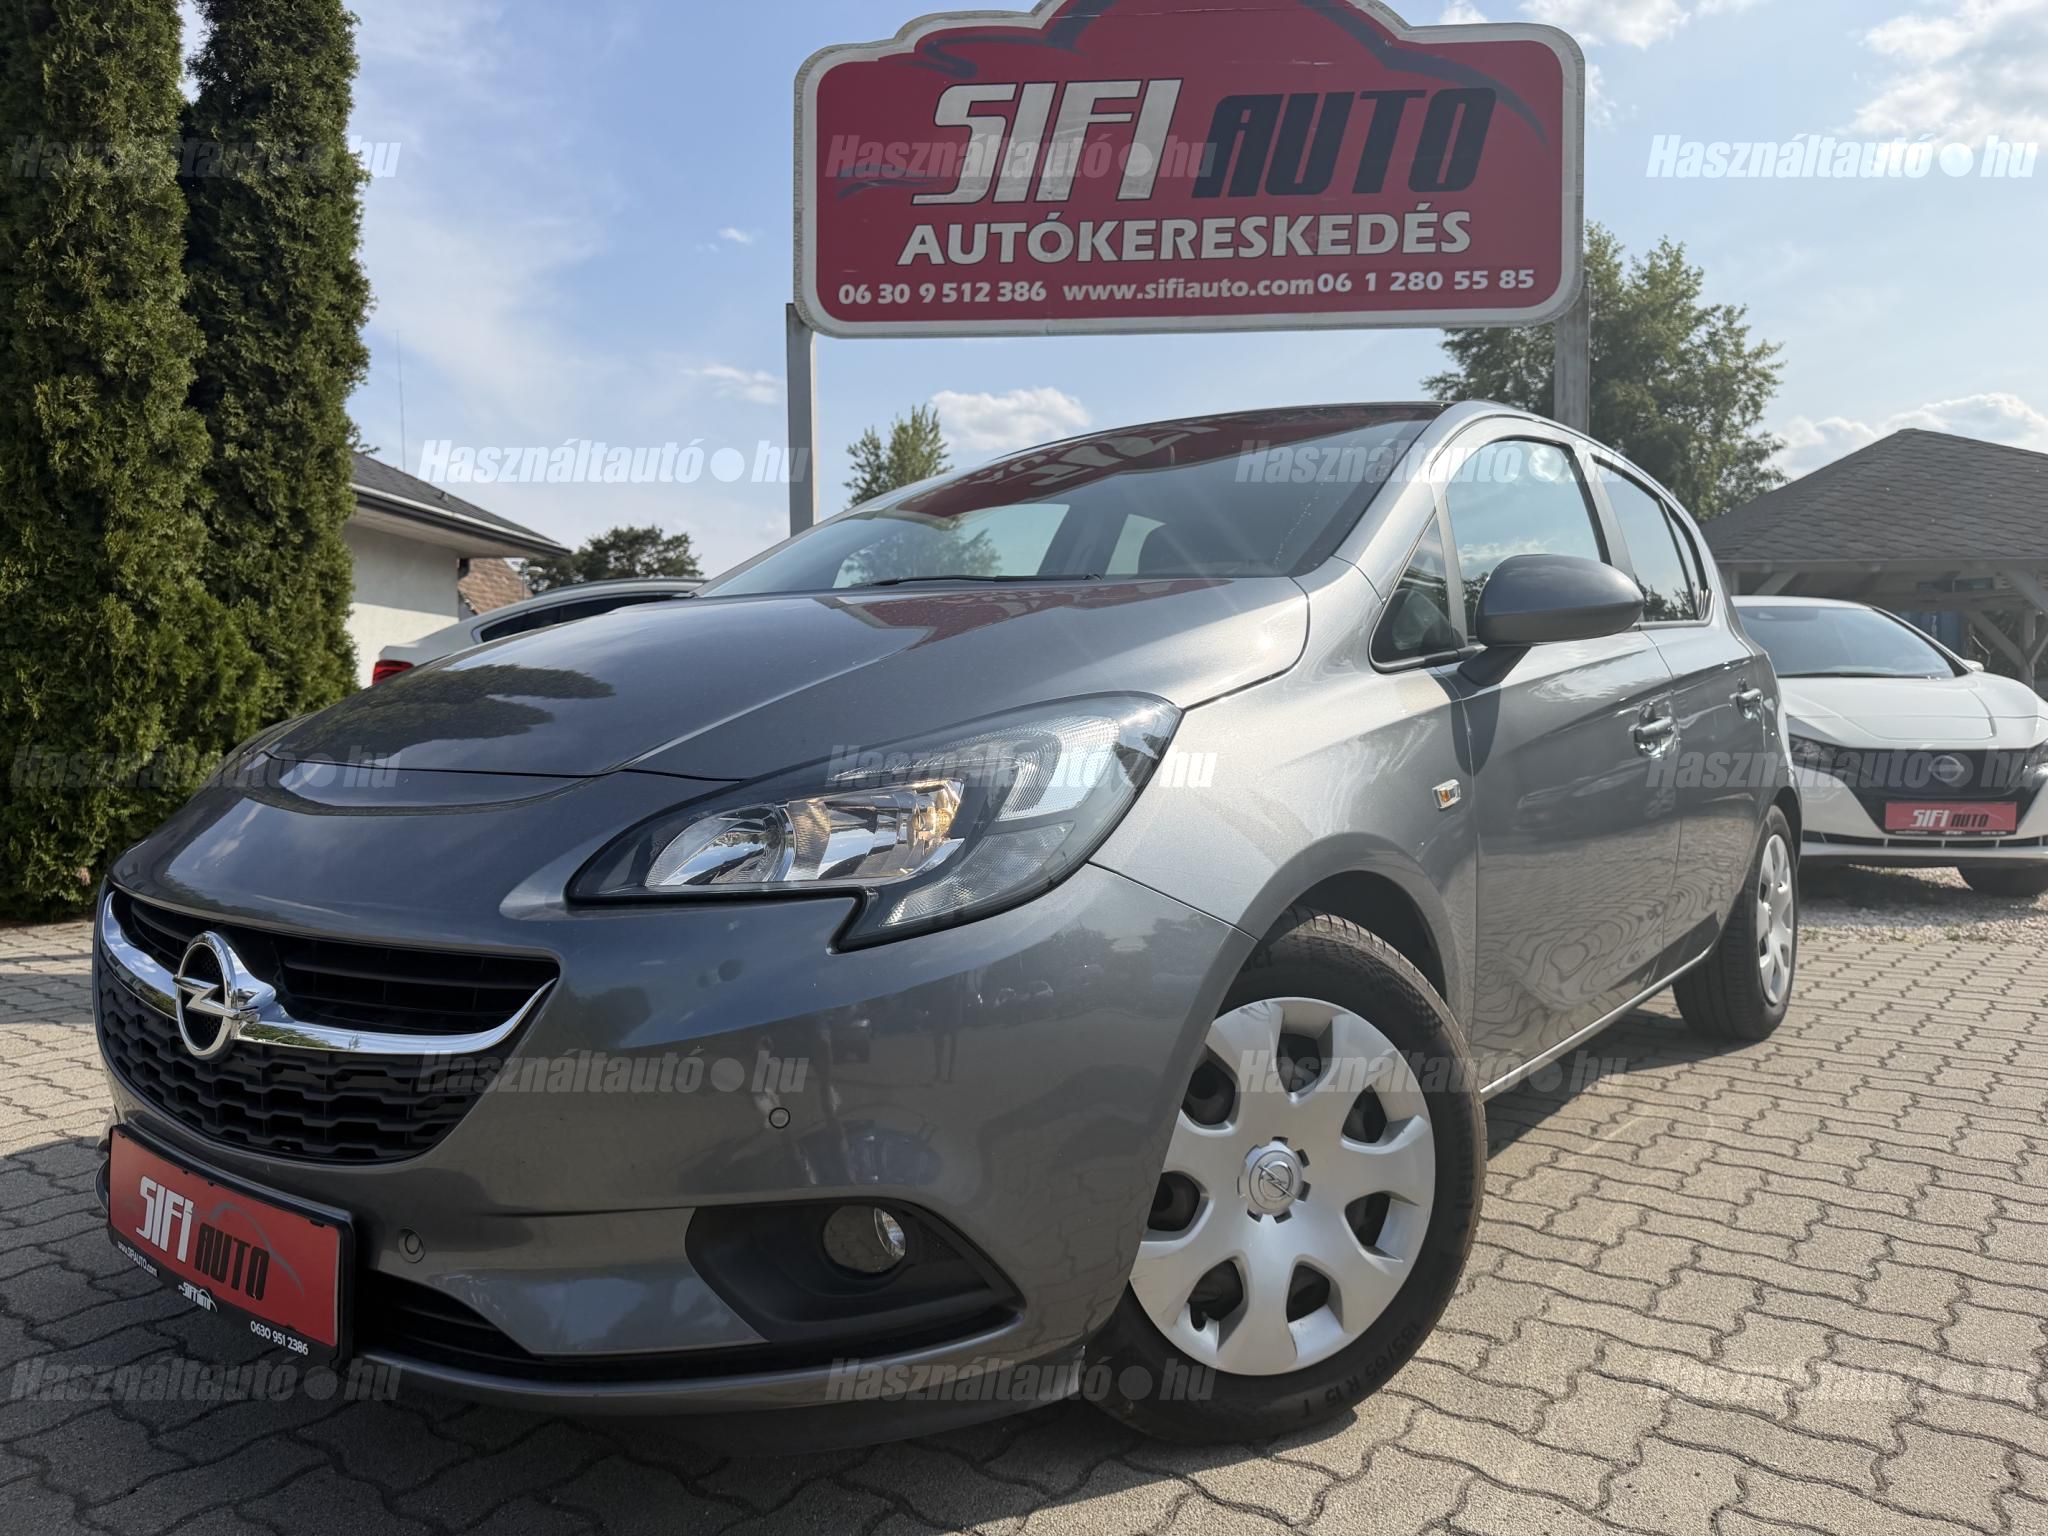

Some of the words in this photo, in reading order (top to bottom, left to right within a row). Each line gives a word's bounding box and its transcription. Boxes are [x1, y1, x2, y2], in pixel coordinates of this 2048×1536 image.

[911, 78, 1183, 206] SIFI
[1191, 87, 1497, 199] AUTO
[896, 202, 1471, 266] AUTÓKERESKEDÉS
[838, 284, 871, 305] 06
[878, 284, 910, 304] 30
[919, 283, 936, 304] 9
[942, 282, 990, 303] 512
[997, 281, 1047, 302] 386
[1063, 278, 1314, 301] www.sifiauto.com
[1316, 272, 1352, 293] 06
[1365, 272, 1377, 292] 1
[1389, 271, 1443, 292] 280
[1454, 270, 1489, 290] 55
[1499, 269, 1535, 289] 85
[194, 1222, 270, 1301] AUTO
[250, 1320, 271, 1340] 0630
[272, 1330, 286, 1347] 951
[287, 1336, 309, 1356] 2386
